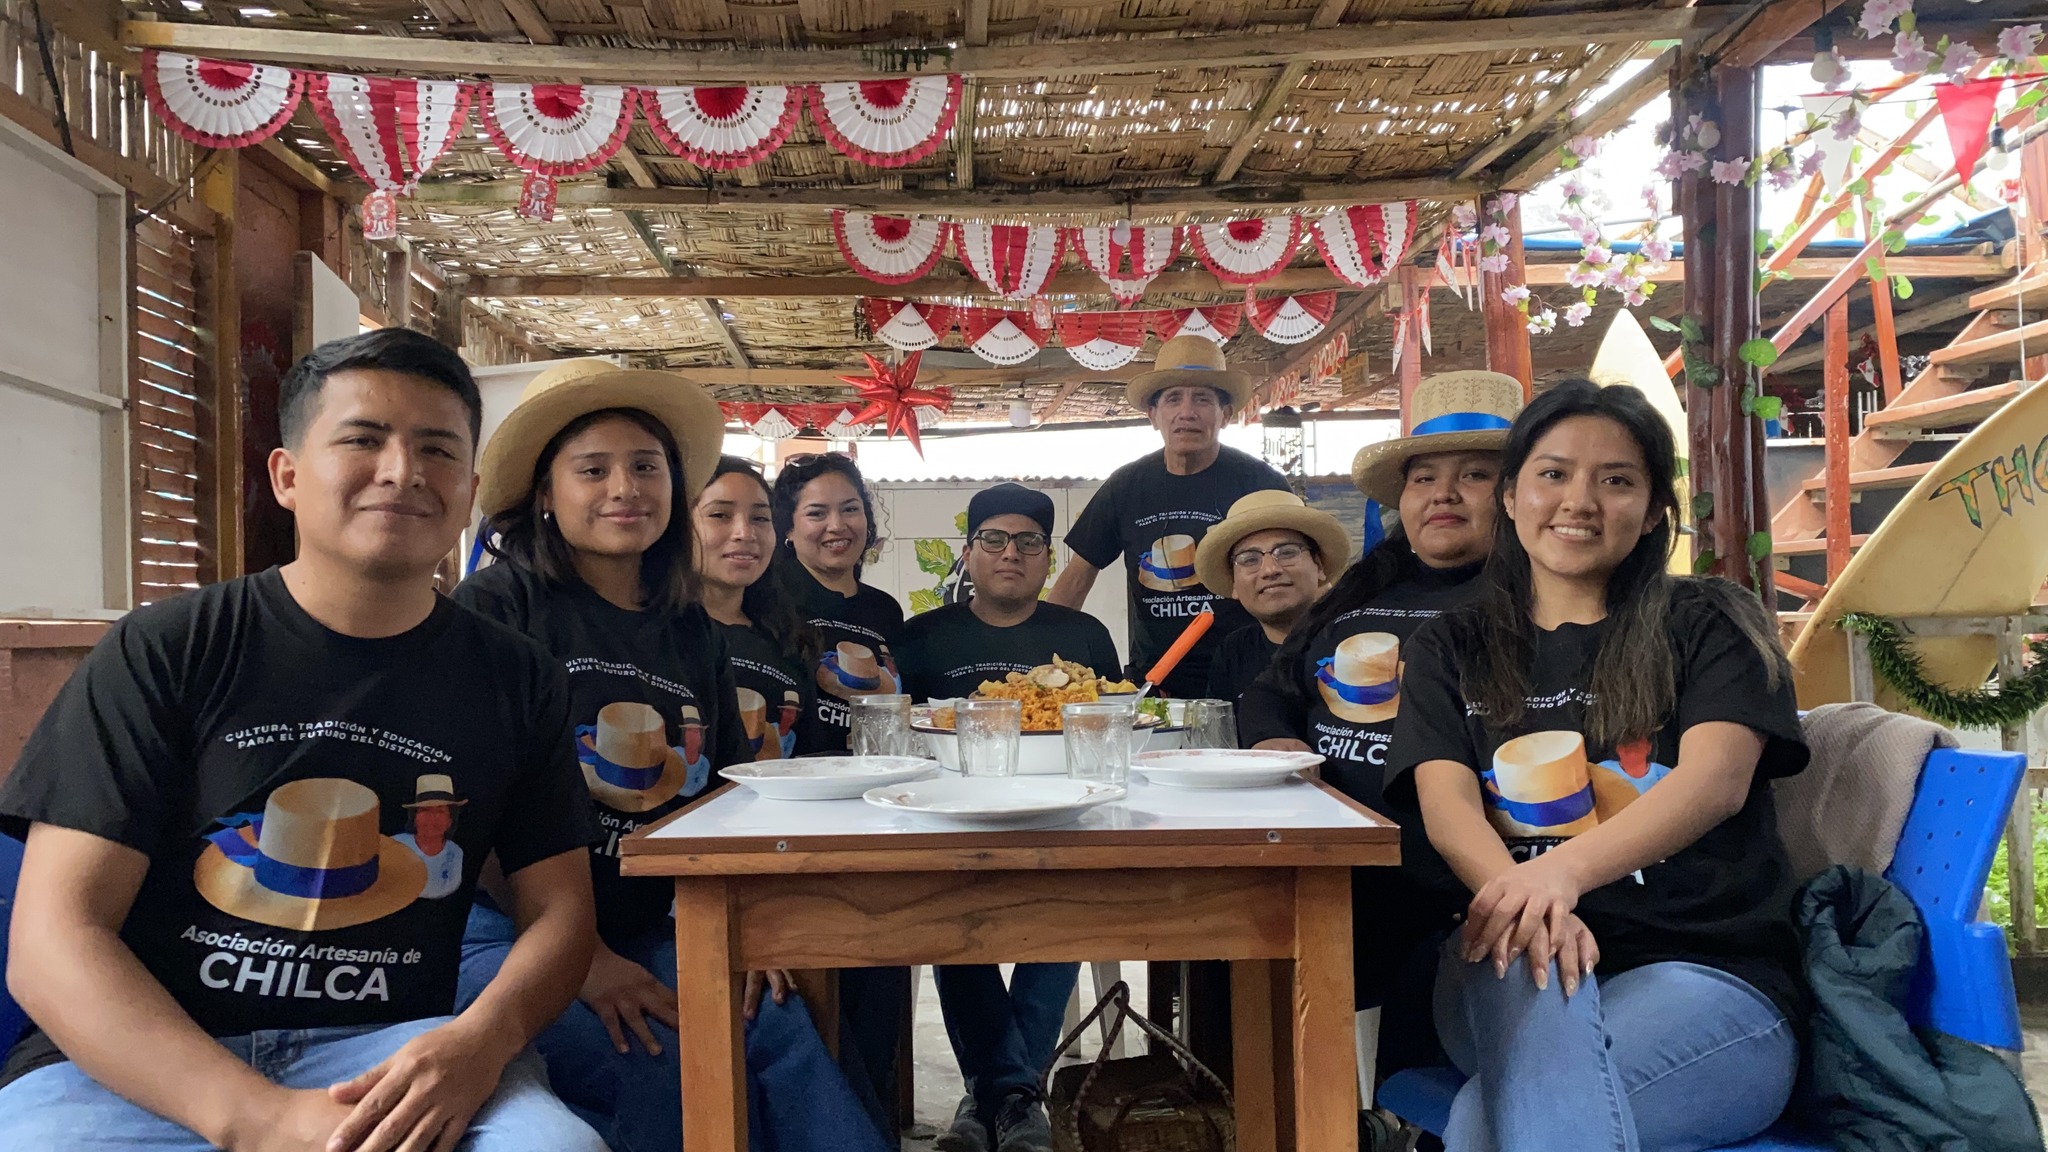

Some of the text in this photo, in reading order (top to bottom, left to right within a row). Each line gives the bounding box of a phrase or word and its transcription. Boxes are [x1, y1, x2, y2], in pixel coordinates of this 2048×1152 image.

[1176, 593, 1213, 602] Artesanía
[1150, 601, 1214, 617] CHILCA
[730, 656, 755, 665] DICIÓN
[568, 664, 593, 674] PARA
[951, 670, 966, 678] PARA
[1557, 695, 1571, 707] DEL
[818, 710, 852, 728] CHI
[1314, 722, 1354, 737] Asociación
[238, 735, 275, 750] PARA
[280, 733, 294, 742] EL
[300, 729, 346, 741] FUTURO
[350, 734, 374, 745] DEL
[298, 720, 366, 734] TRADICIÓN
[382, 730, 452, 763] EDUCACIÓN
[1317, 735, 1388, 766] CHILC
[180, 925, 422, 965] Asociación Artesanía de
[199, 951, 390, 1002] CHILCA
